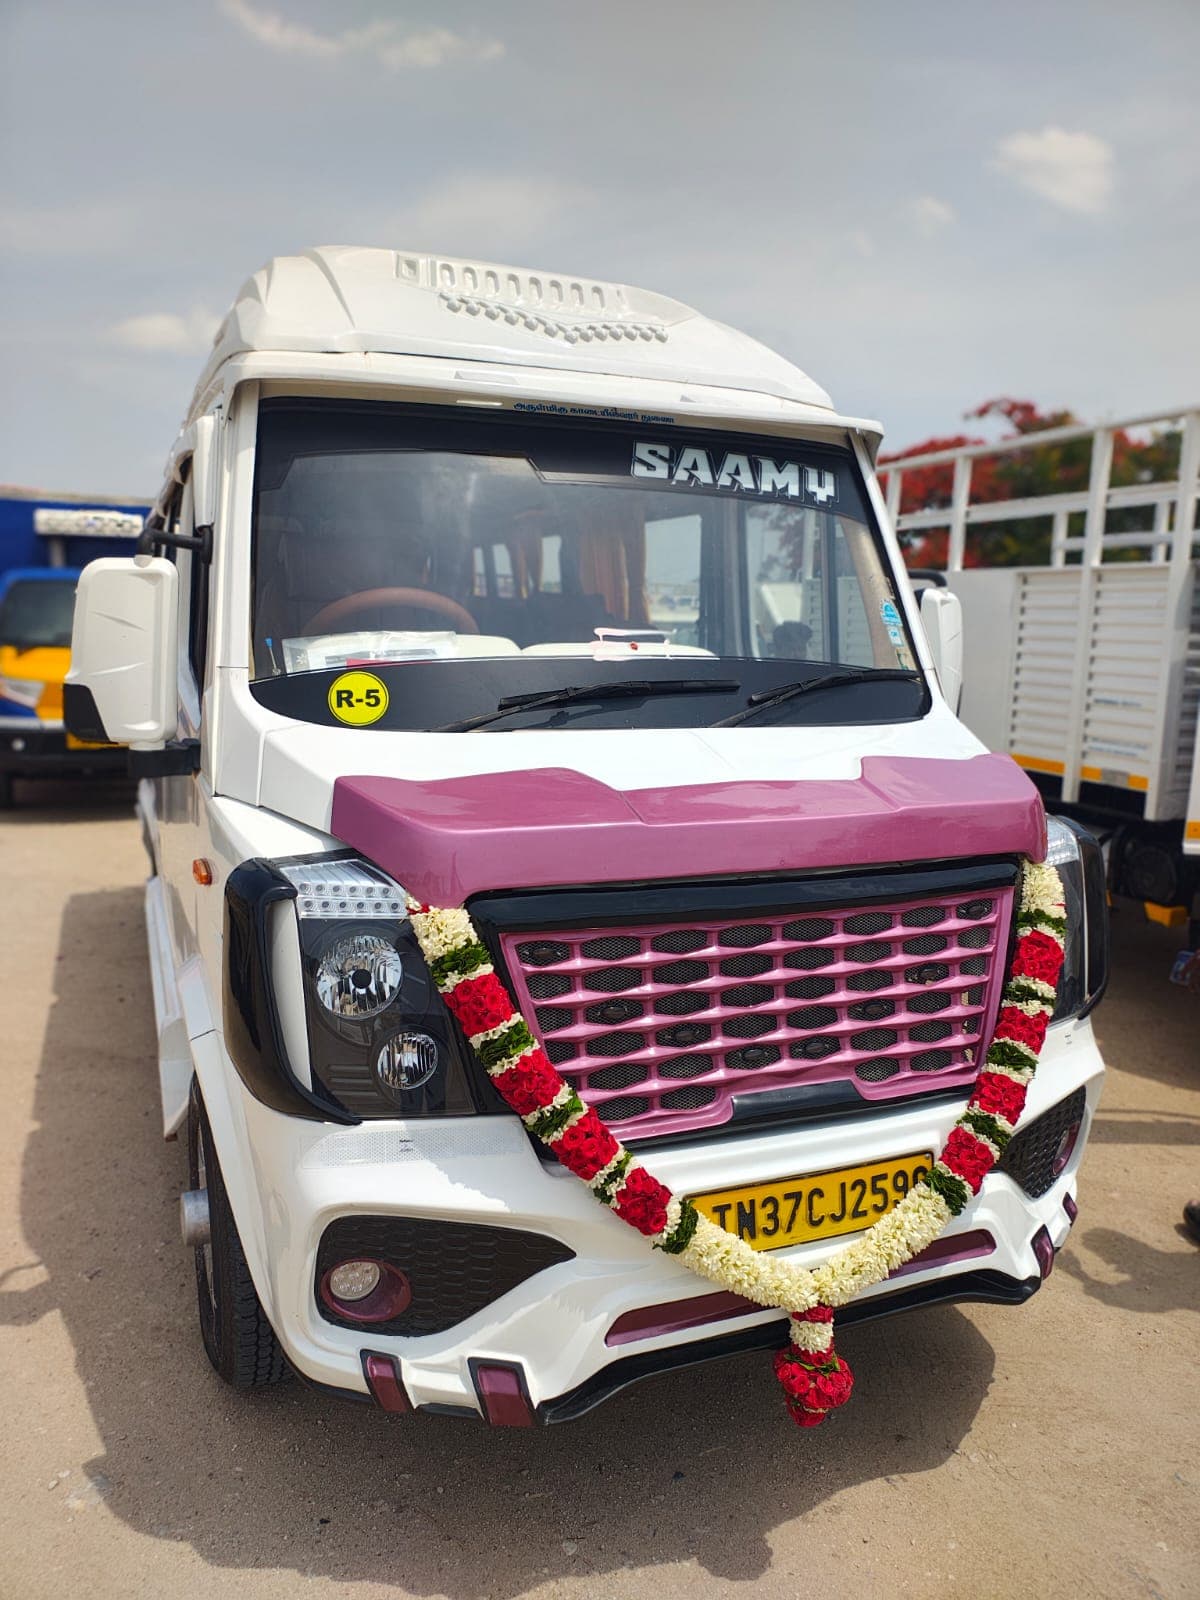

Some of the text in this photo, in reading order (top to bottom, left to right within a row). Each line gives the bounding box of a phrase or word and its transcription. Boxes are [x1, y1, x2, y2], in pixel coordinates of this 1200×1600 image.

[514, 402, 568, 415] அருள்மிகு
[631, 440, 839, 507] SAAMY
[336, 689, 381, 708] R-5
